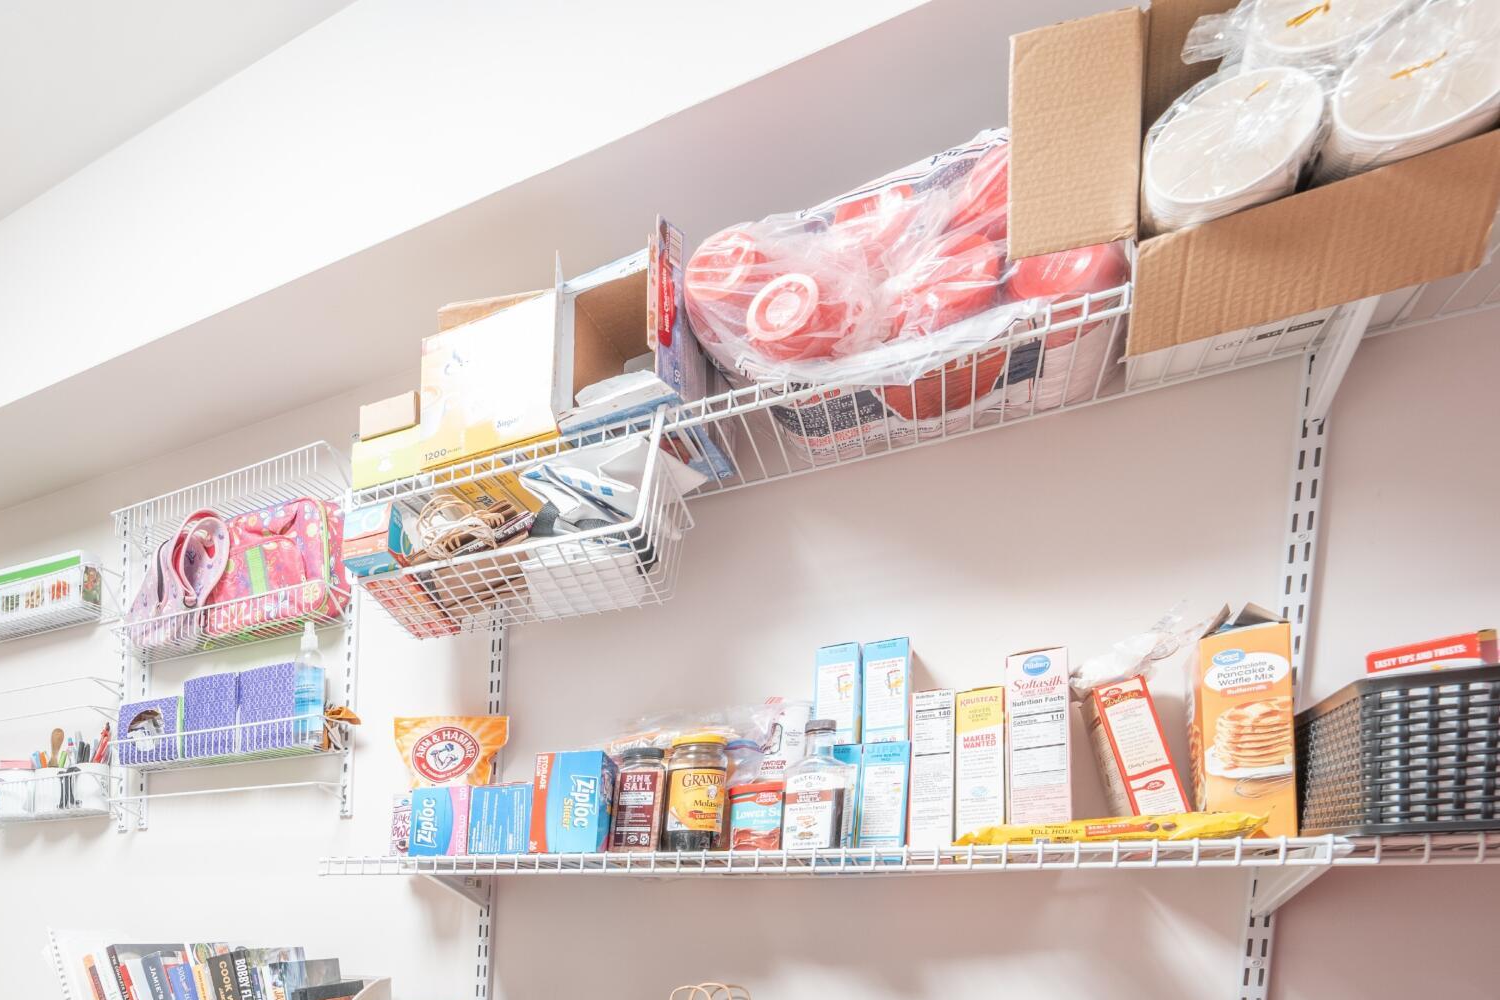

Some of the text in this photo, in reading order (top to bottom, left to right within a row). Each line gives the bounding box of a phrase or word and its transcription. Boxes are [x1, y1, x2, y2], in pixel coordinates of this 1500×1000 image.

[424, 448, 447, 461] 1200
[1223, 660, 1268, 672] Complete
[1374, 658, 1397, 670] TASTY
[1398, 654, 1415, 665] TIPS
[1416, 650, 1433, 661] AND
[1217, 667, 1265, 679] Pancake
[1011, 675, 1066, 692] Softasilk
[1217, 672, 1275, 688] Waffle Mix
[960, 694, 999, 707] KRUSTEAZ
[1012, 694, 1065, 708] Nutrition Facts
[938, 709, 951, 718] 140
[1050, 712, 1065, 721] 110
[963, 733, 997, 743] MAKERS
[415, 731, 475, 759] ARM & HAMMER
[963, 740, 997, 750] WANTED
[540, 755, 549, 790] STORAGE
[625, 774, 652, 783] PINK
[623, 782, 653, 791] SALT
[571, 779, 596, 829] Ziploc
[416, 797, 438, 845] Ziploc
[735, 809, 764, 821] Lower
[219, 960, 233, 993] COOK
[235, 958, 251, 988] BOBBY
